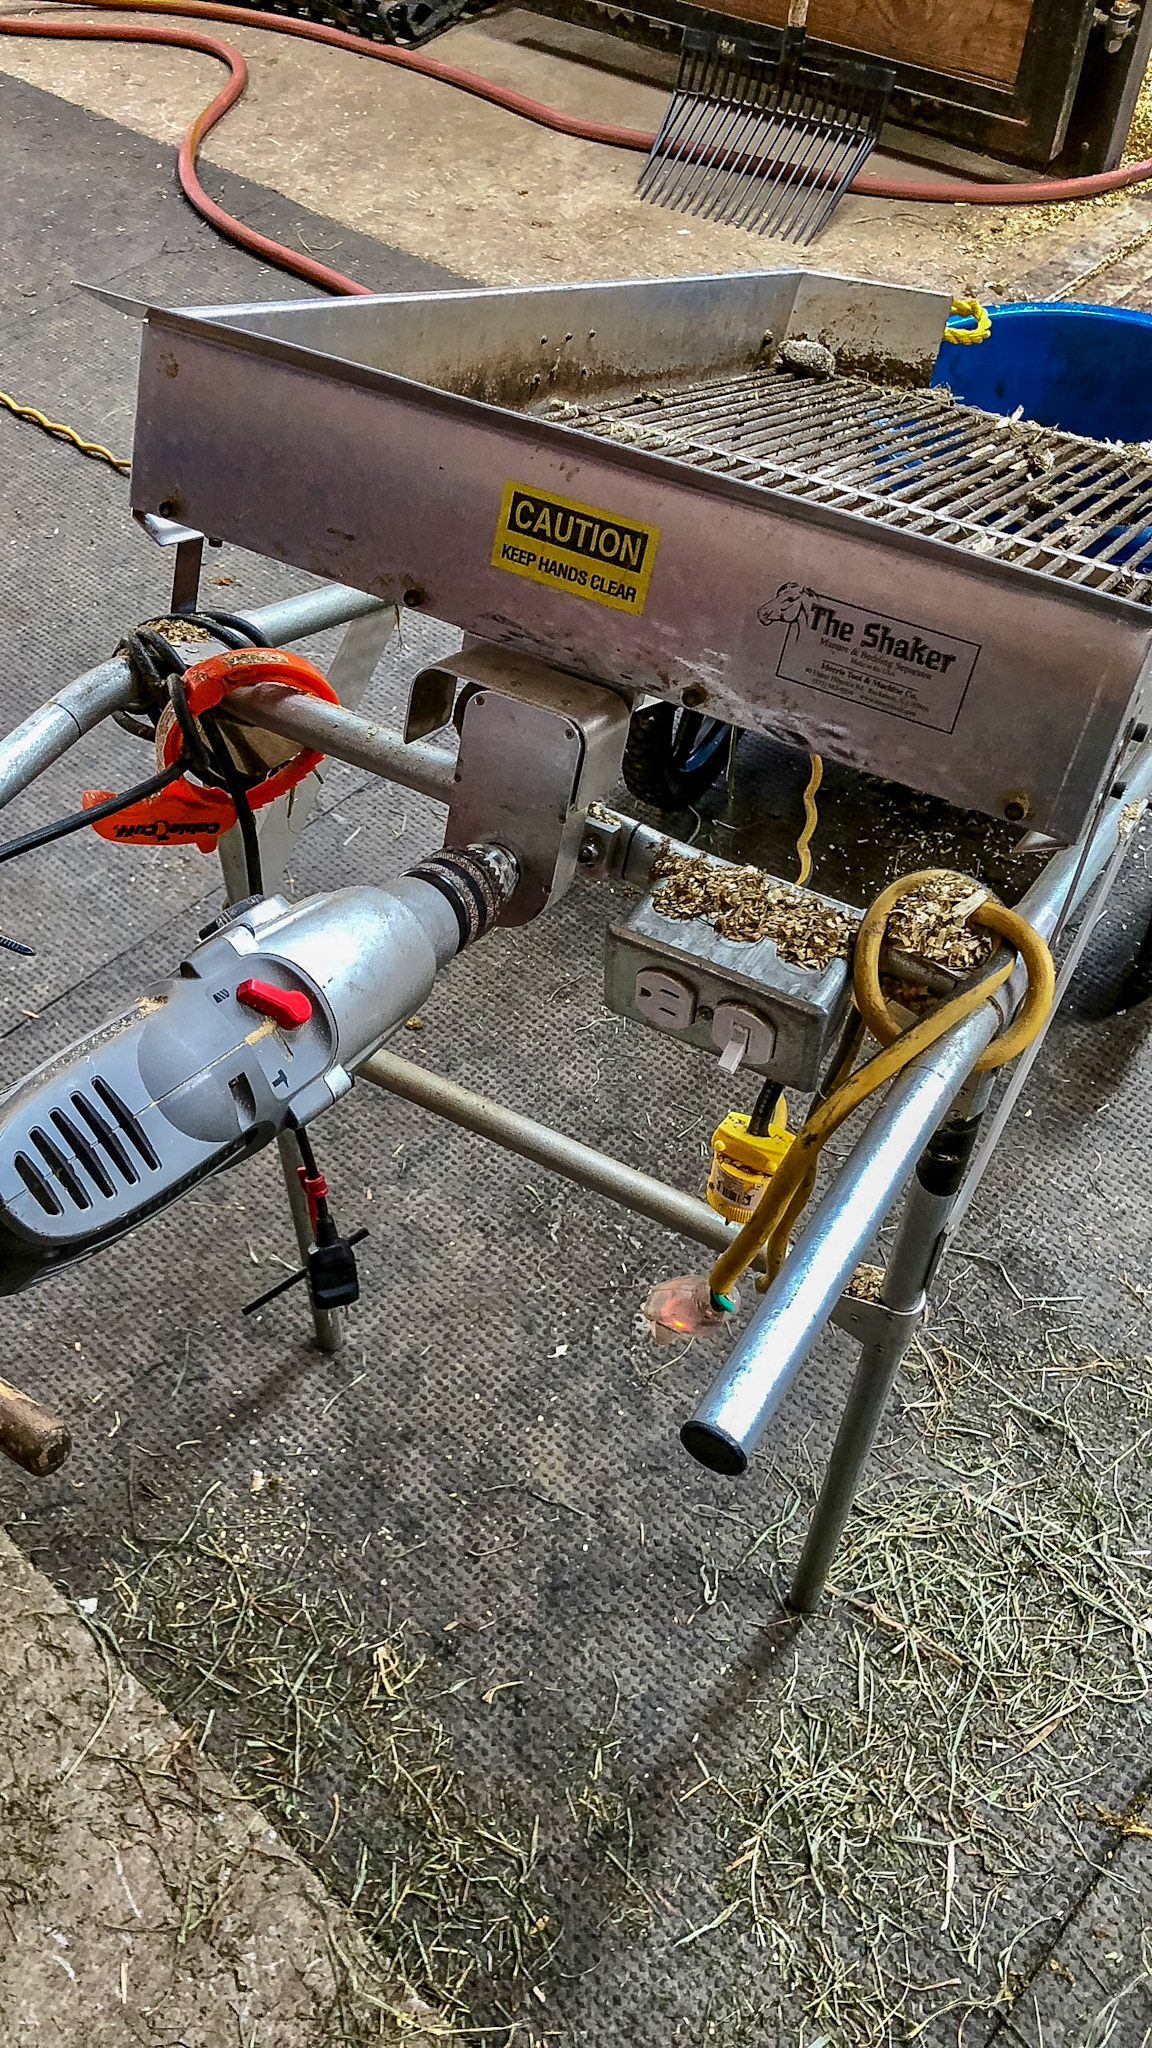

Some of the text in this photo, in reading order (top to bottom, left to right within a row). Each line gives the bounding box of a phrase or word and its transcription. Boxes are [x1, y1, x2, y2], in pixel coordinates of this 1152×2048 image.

[515, 500, 642, 566] CAUTION
[501, 543, 637, 602] KEEP HANDS CLEAR
[810, 603, 957, 674] The Shaker
[819, 637, 849, 653] Manure
[850, 647, 858, 656] &
[859, 650, 893, 669] Bedding
[820, 662, 845, 676] Morris
[846, 671, 862, 681] Tool
[872, 679, 903, 695] Machine
[904, 690, 918, 699] Co.
[169, 822, 220, 835] Cable
